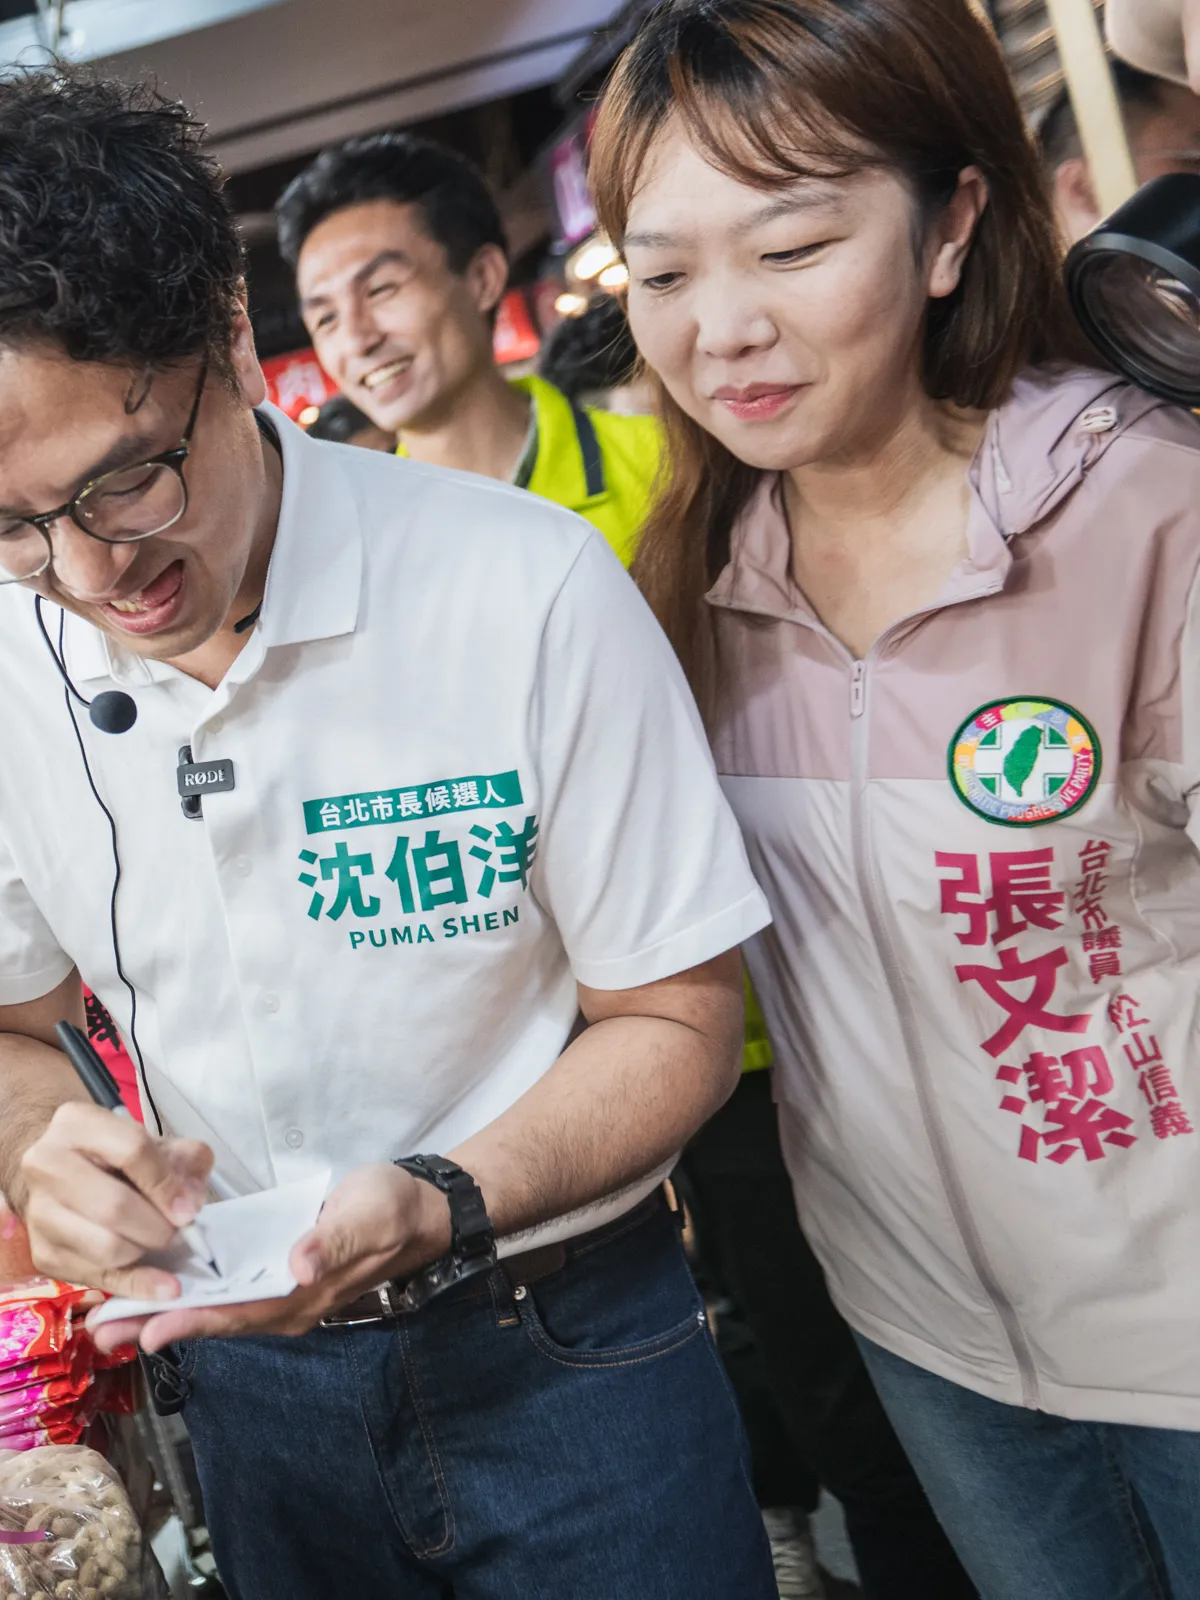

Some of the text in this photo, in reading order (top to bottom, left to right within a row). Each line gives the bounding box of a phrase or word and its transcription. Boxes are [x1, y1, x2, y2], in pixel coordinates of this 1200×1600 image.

[319, 780, 506, 828] 台北市長候選人
[298, 815, 538, 922] 沈伯洋
[349, 905, 520, 950] PUMA SHEN
[934, 846, 1139, 1166] 張文潔
